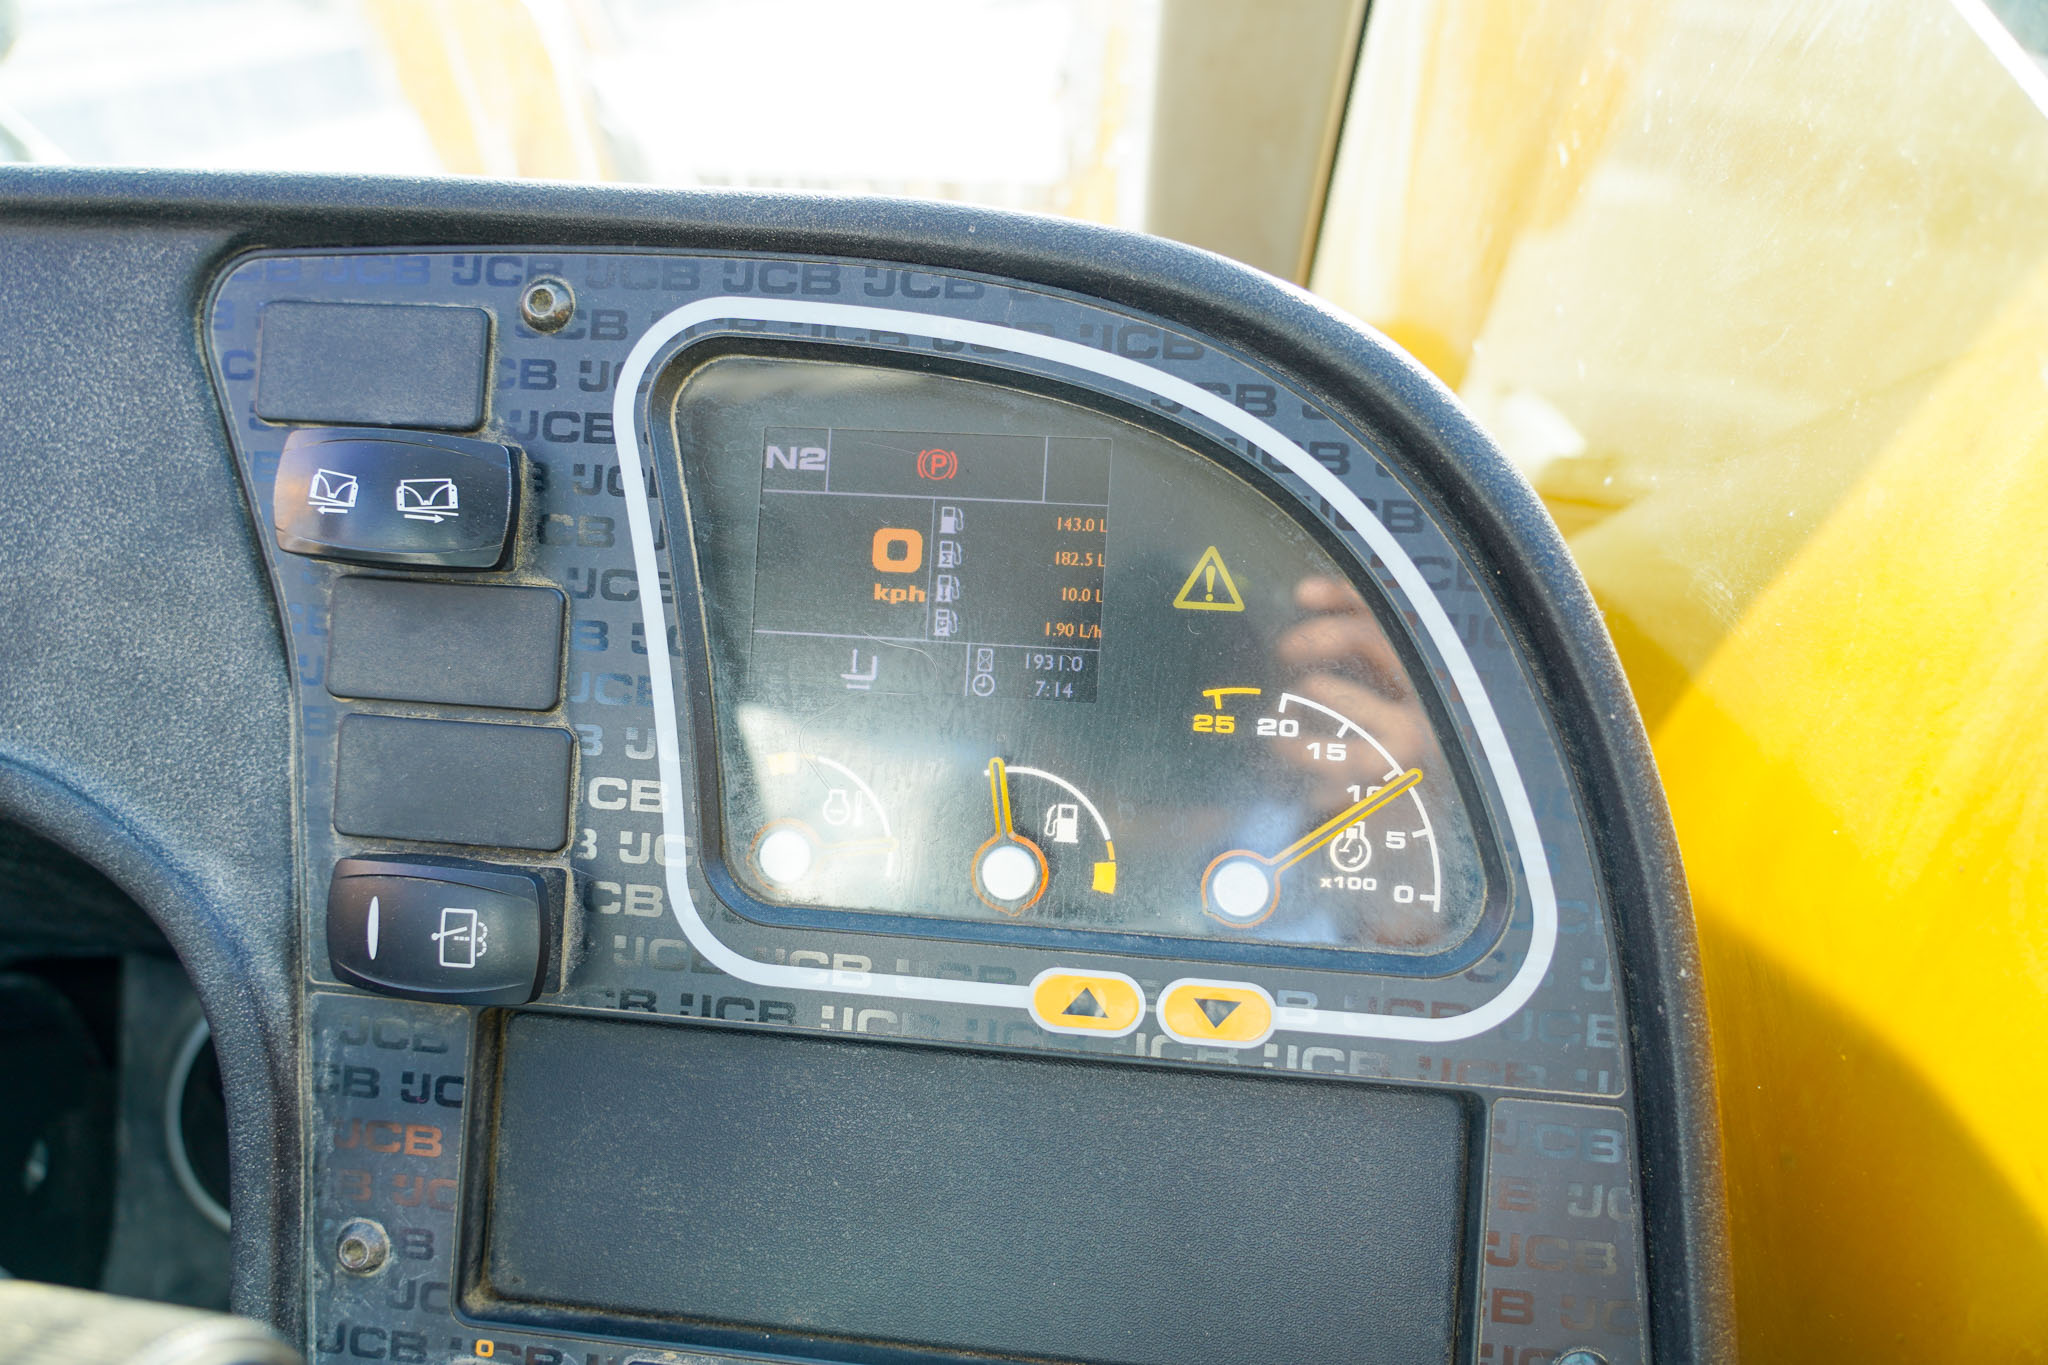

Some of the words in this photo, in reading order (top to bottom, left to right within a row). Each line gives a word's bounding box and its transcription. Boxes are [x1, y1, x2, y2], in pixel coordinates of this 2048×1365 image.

[765, 445, 827, 471] N2
[1056, 516, 1095, 532] 143.0
[1100, 519, 1108, 533] L
[872, 528, 923, 573] 0
[1055, 551, 1093, 567] 182.5
[1098, 553, 1105, 567] L
[873, 583, 926, 605] kph
[1062, 587, 1091, 602] 10.0
[1096, 589, 1103, 603] L
[1045, 622, 1075, 637] 1.90
[1079, 624, 1102, 639] L/h
[1025, 653, 1083, 672] 1931.0
[1035, 680, 1074, 699] 7:14
[1193, 714, 1235, 734] 25
[1256, 718, 1299, 738] 20
[1307, 742, 1347, 762] 15
[580, 777, 668, 813] CB
[1386, 831, 1406, 849] 5
[1320, 876, 1377, 891] x100
[1394, 886, 1414, 904] 0
